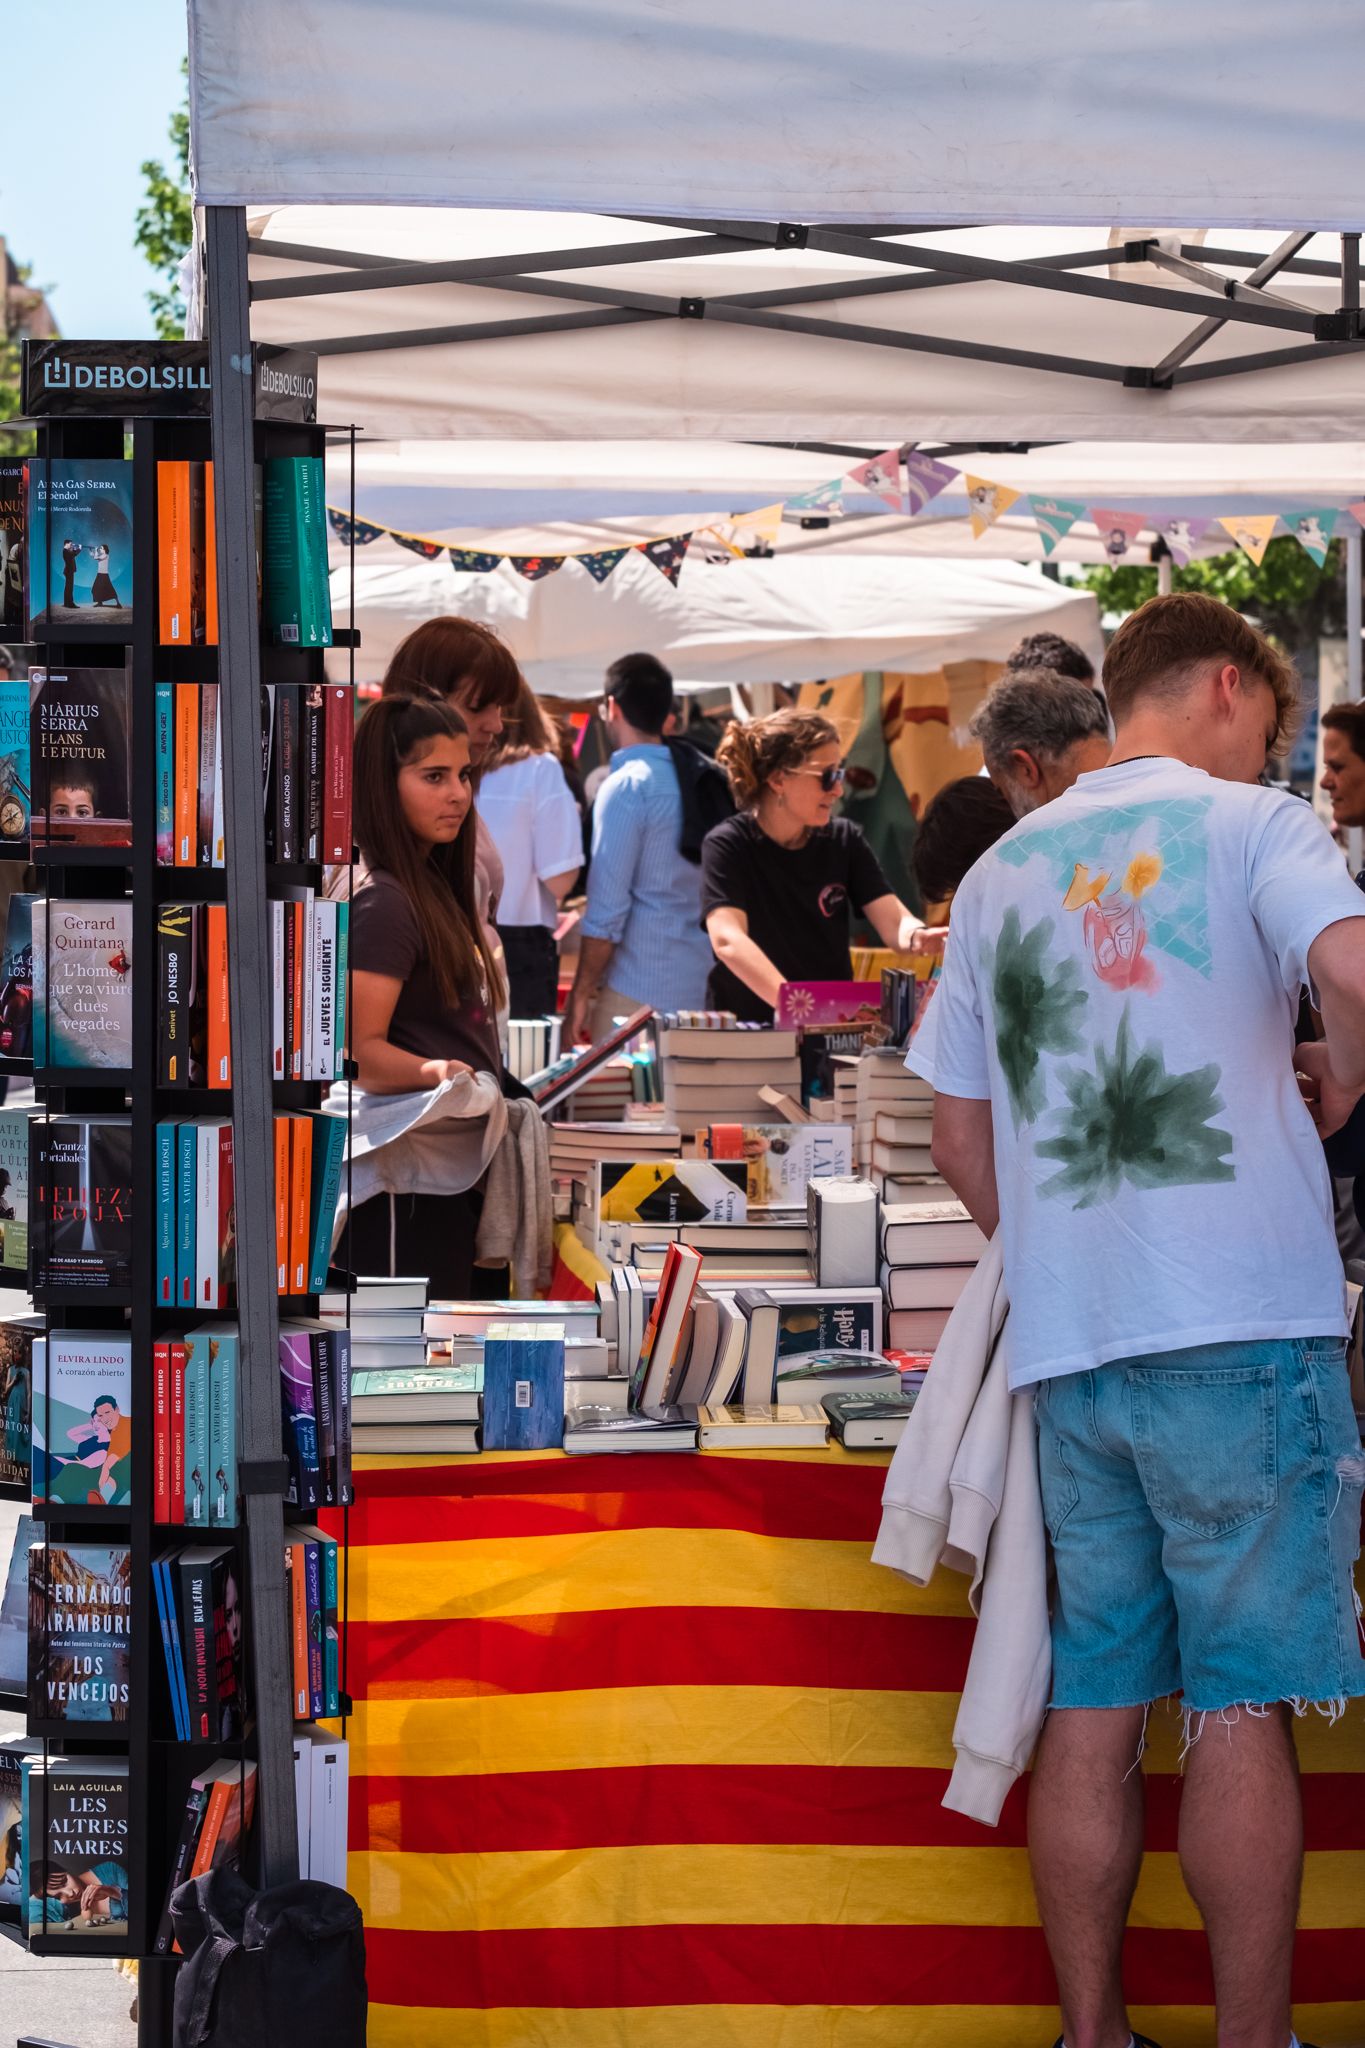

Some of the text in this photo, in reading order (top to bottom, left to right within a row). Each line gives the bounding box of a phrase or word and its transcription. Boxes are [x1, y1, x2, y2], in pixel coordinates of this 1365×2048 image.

[87, 480, 116, 489] SERRA
[41, 702, 99, 717] MÀRIUS
[41, 718, 88, 731] SERRA
[1, 730, 30, 744] USTO
[311, 736, 317, 746] DE
[61, 747, 106, 759] FUTUR
[64, 917, 116, 930] Gerard
[56, 934, 124, 951] Quintana
[12, 955, 23, 965] LA
[322, 938, 331, 993] SIGUIENTE
[8, 967, 26, 977] LOS
[64, 964, 117, 977] L'home
[168, 953, 177, 988] NESBØ
[50, 984, 72, 996] que
[78, 984, 93, 994] va
[168, 991, 179, 1004] JO
[74, 999, 108, 1012] dues
[321, 996, 331, 1035] JUEVES
[62, 1018, 120, 1033] vegades
[51, 1140, 86, 1150] Arantza
[162, 1139, 170, 1203] XAVIER BOSCH
[324, 1120, 344, 1211] DANIELLE STEEL
[670, 1193, 680, 1205] La
[53, 1205, 124, 1223] ROJA
[832, 1307, 855, 1347] Harry
[58, 1355, 124, 1364] ELVIRA LINDO
[319, 1341, 327, 1369] QUERER
[66, 1368, 95, 1376] corazón
[98, 1369, 124, 1377] abierto
[342, 1395, 348, 1404] LA
[198, 1404, 205, 1414] LA
[222, 1403, 229, 1414] LA
[198, 1417, 205, 1428] DE
[222, 1417, 229, 1427] DE
[322, 1412, 330, 1426] LAS
[198, 1456, 205, 1467] LA
[222, 1455, 229, 1466] LA
[192, 1579, 204, 1622] BLUE JEANS
[74, 1656, 103, 1675] LOS
[194, 1627, 207, 1702] LA NOIA INVISIBLE
[48, 1682, 129, 1702] VENCEJOS
[79, 1784, 122, 1792] AGUILAR
[70, 1798, 107, 1812] LES
[48, 1819, 128, 1835] ALTRES
[53, 1840, 123, 1856] MARES
